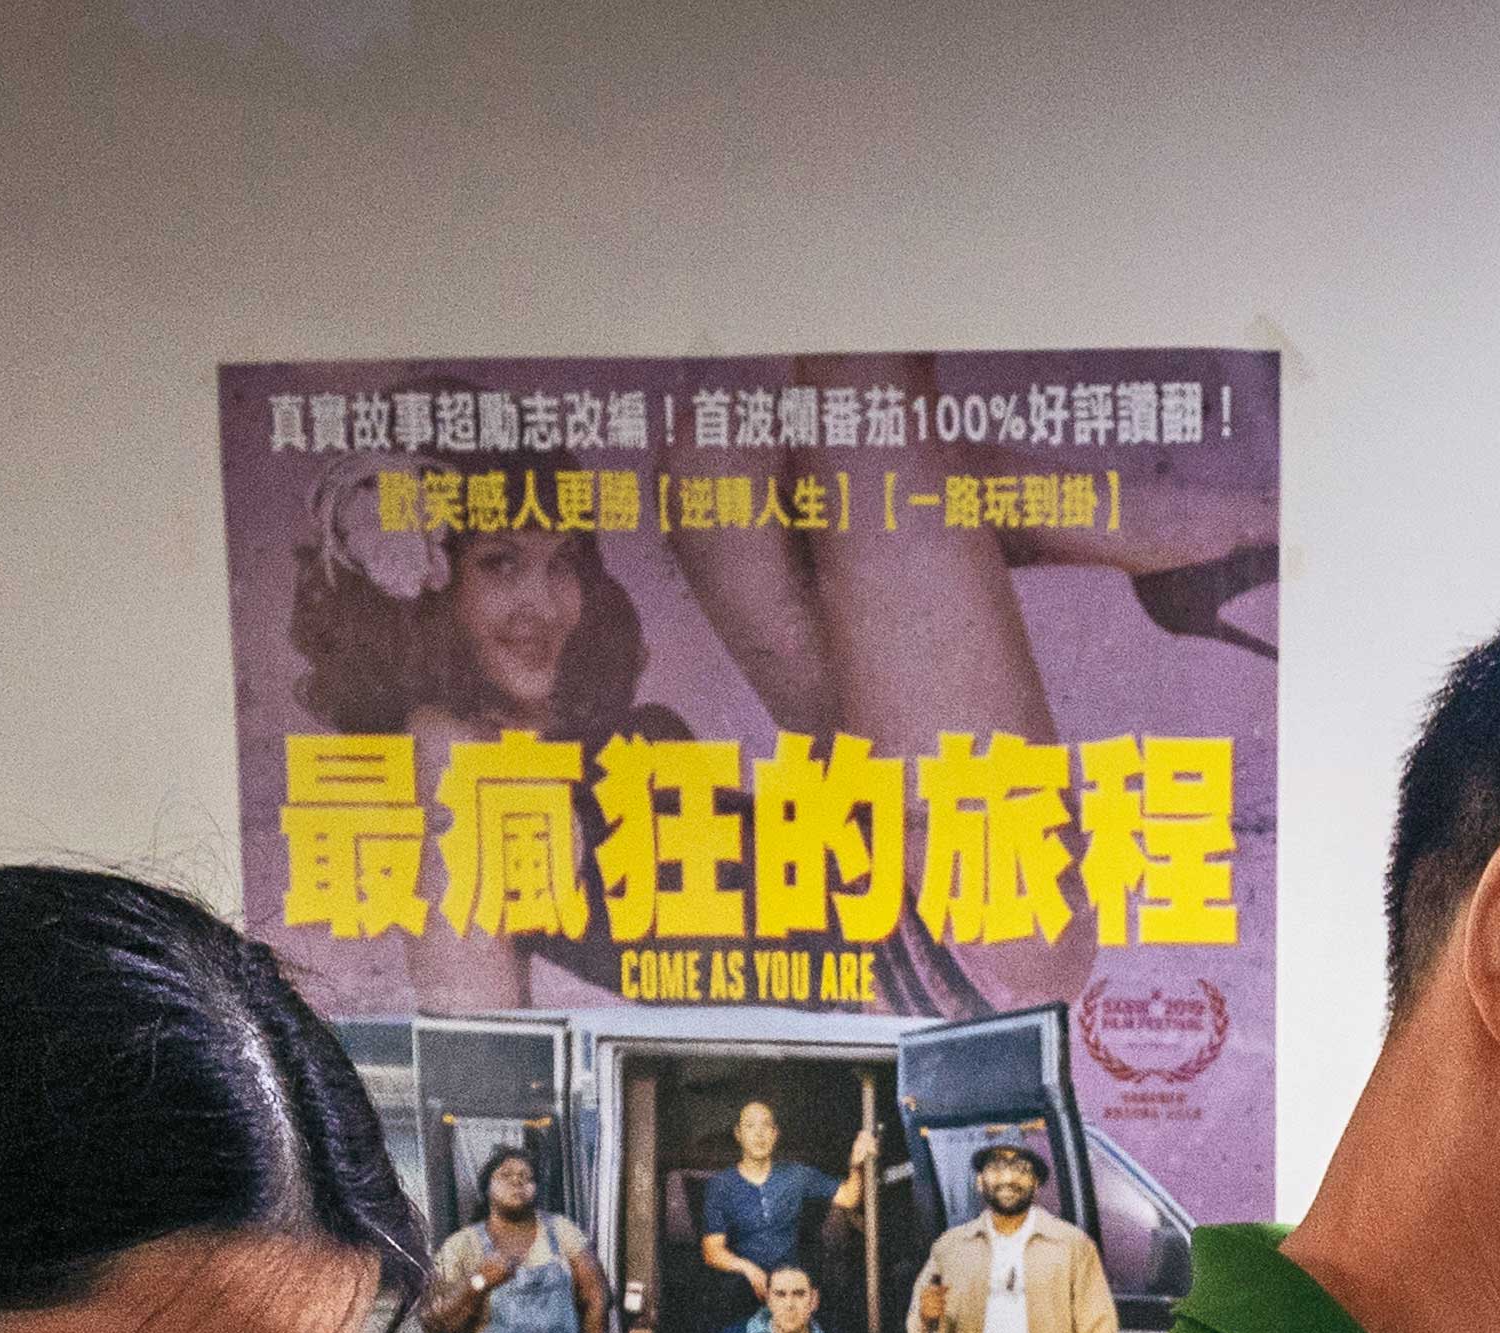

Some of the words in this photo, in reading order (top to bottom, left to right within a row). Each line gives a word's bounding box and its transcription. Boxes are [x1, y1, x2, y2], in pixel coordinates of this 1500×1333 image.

[280, 730, 1238, 944] 最瘋狂的旅程
[621, 950, 702, 1000] COME
[709, 950, 745, 1001] AS
[754, 950, 810, 1001] YOU
[819, 951, 876, 1001] ARE
